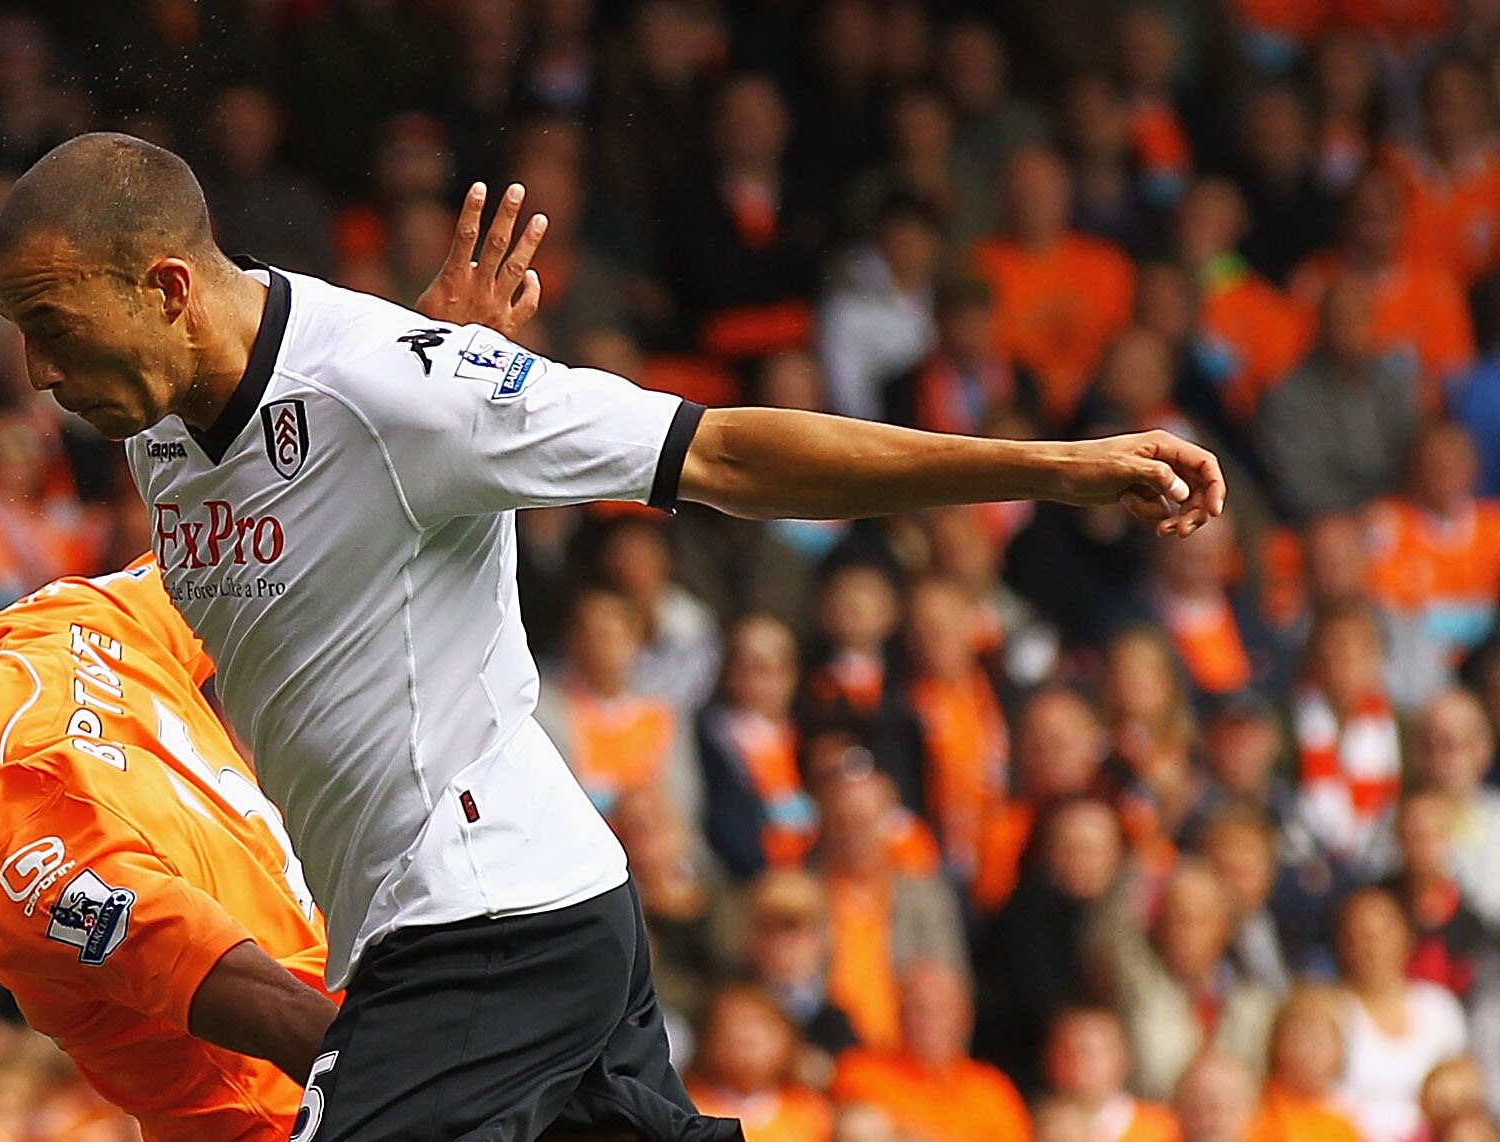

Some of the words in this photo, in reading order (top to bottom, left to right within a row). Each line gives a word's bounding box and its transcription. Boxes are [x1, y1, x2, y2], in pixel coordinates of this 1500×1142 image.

[153, 500, 285, 571] FxPro
[186, 580, 219, 601] Forex
[244, 583, 253, 598] a
[256, 577, 287, 598] Pro
